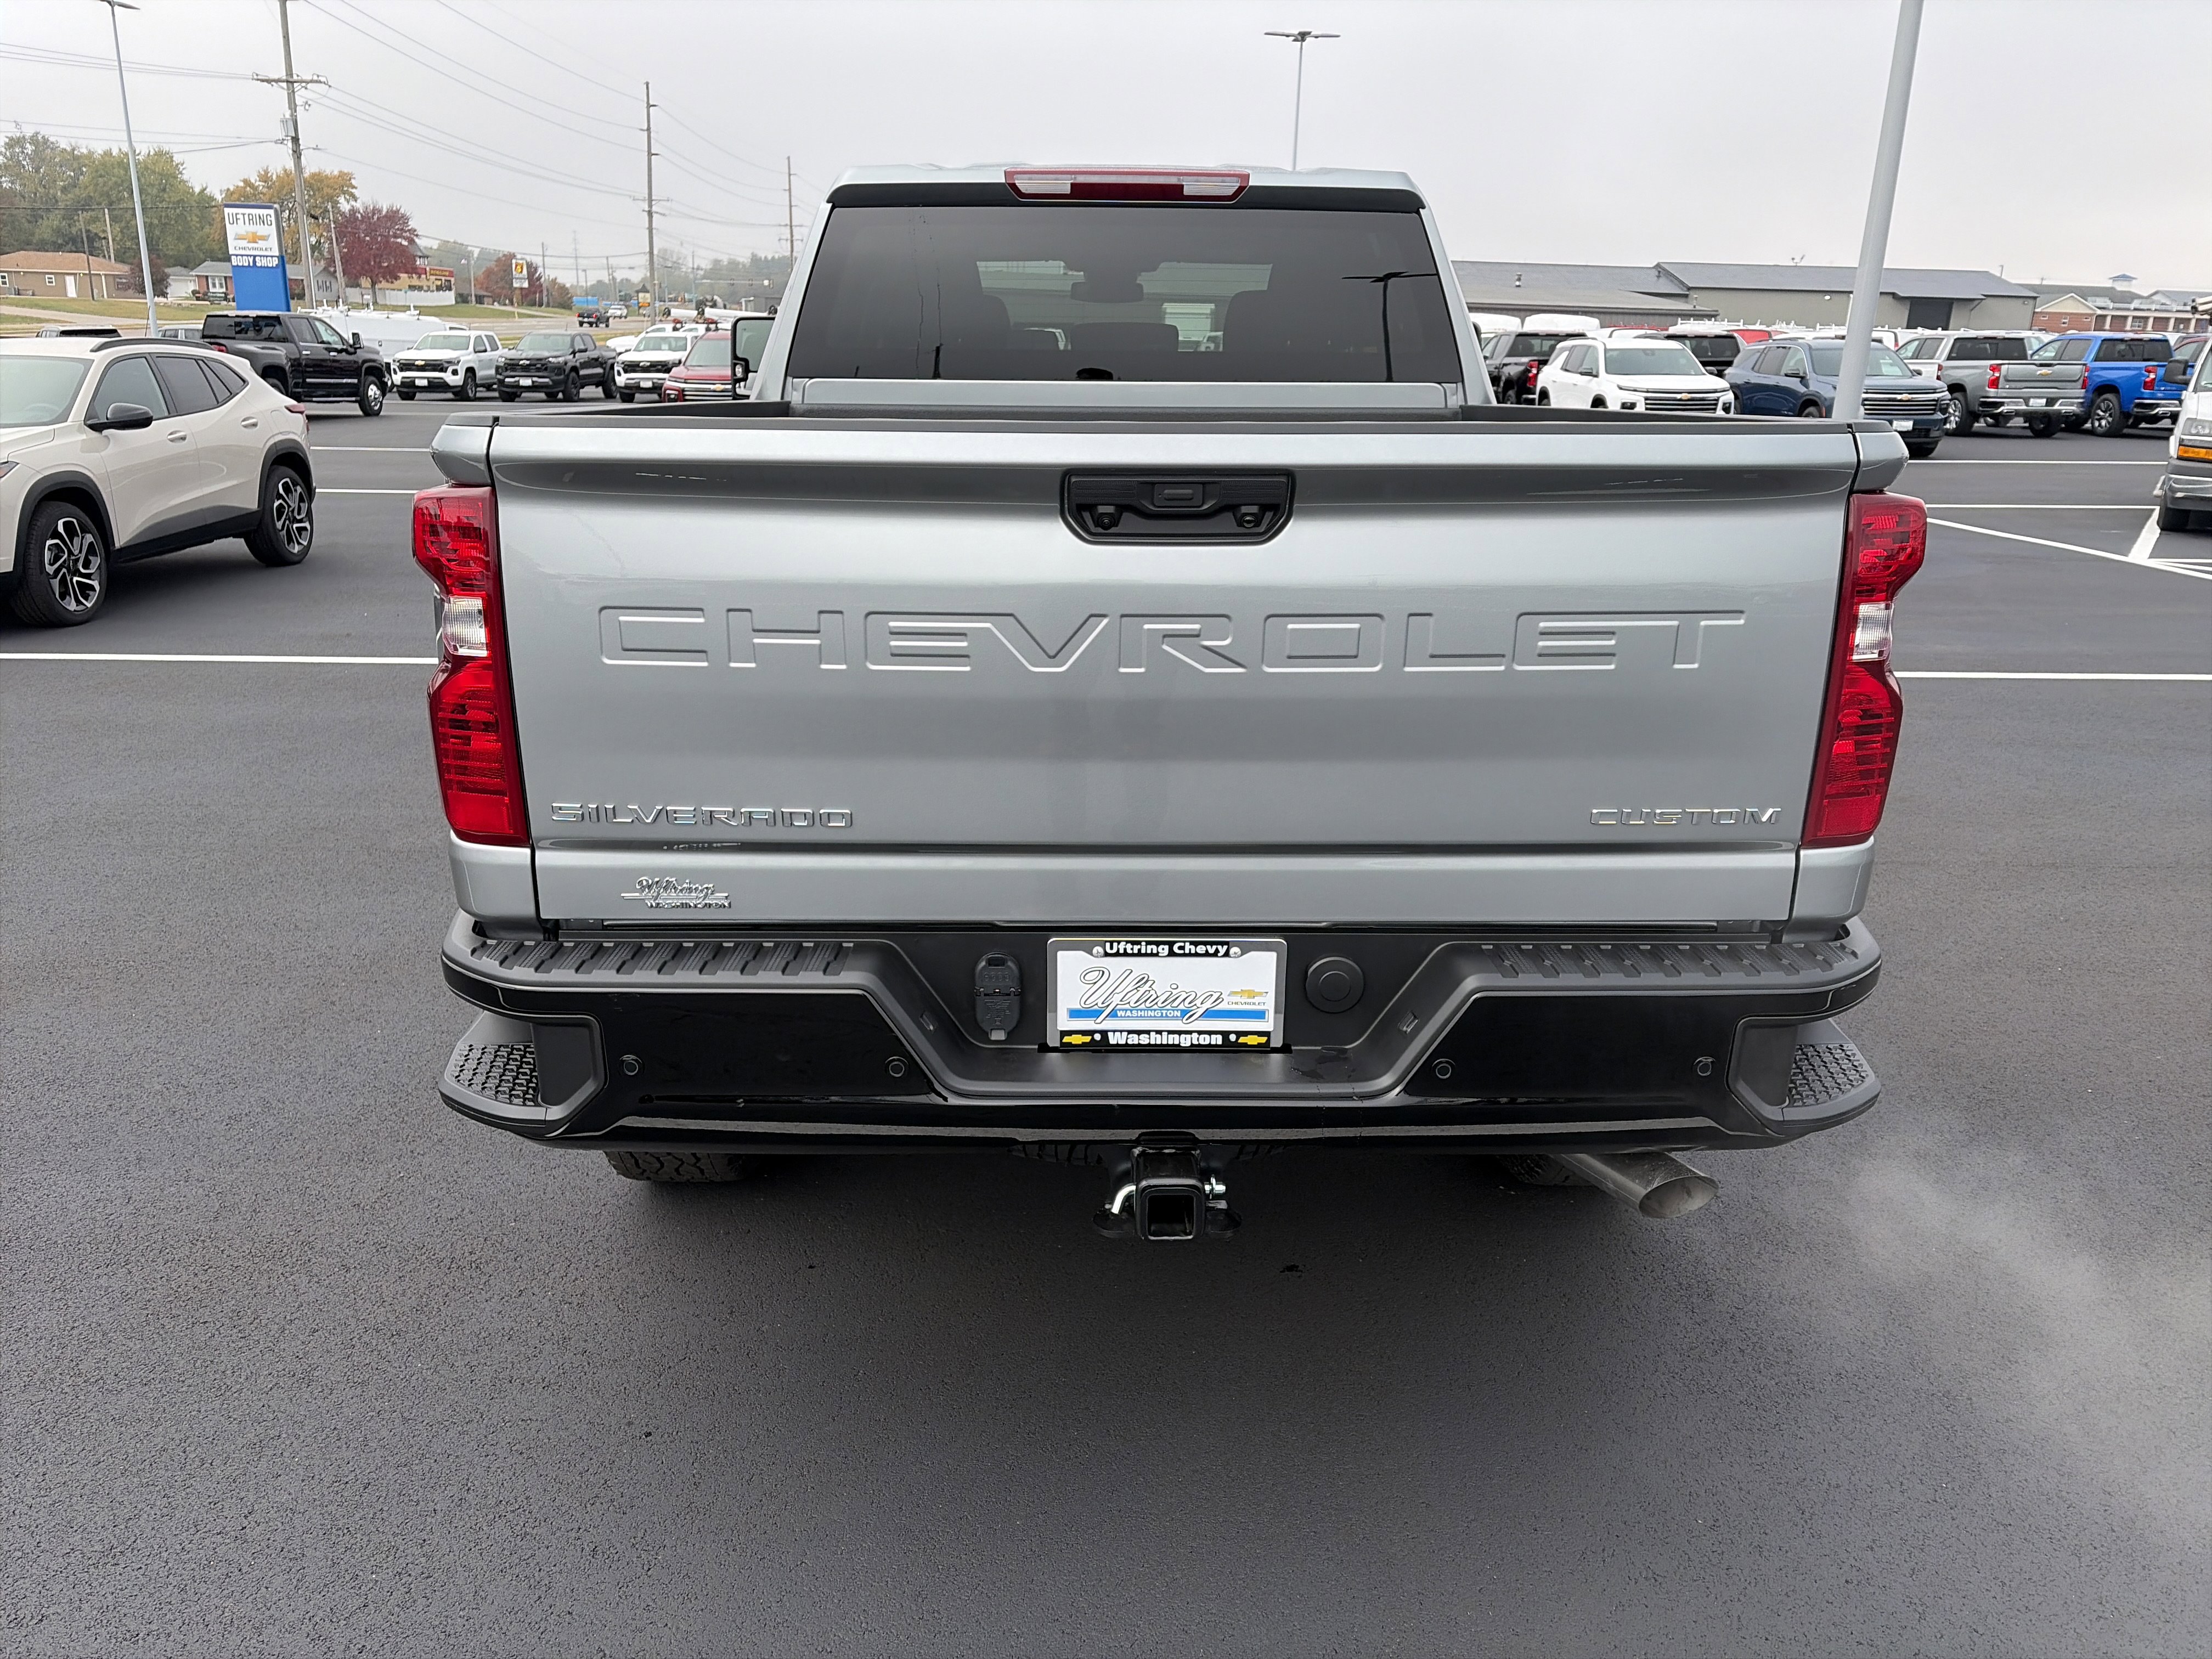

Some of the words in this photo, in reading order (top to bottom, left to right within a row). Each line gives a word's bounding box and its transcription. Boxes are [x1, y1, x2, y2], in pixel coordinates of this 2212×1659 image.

[228, 212, 272, 226] UFTRING
[231, 255, 253, 266] BODY
[256, 256, 278, 267] SHOP
[599, 605, 1745, 673] CHEVROLET
[551, 802, 853, 827] SILVERADO
[1590, 808, 1782, 825] CUSTOM
[644, 900, 732, 909] WASHINGTON
[1105, 942, 1169, 956] Uftring
[1173, 942, 1228, 956] Chevy
[1080, 967, 1224, 1024] Uftring
[1116, 1009, 1181, 1017] WASHINGTON
[1107, 1031, 1223, 1047] Washington
